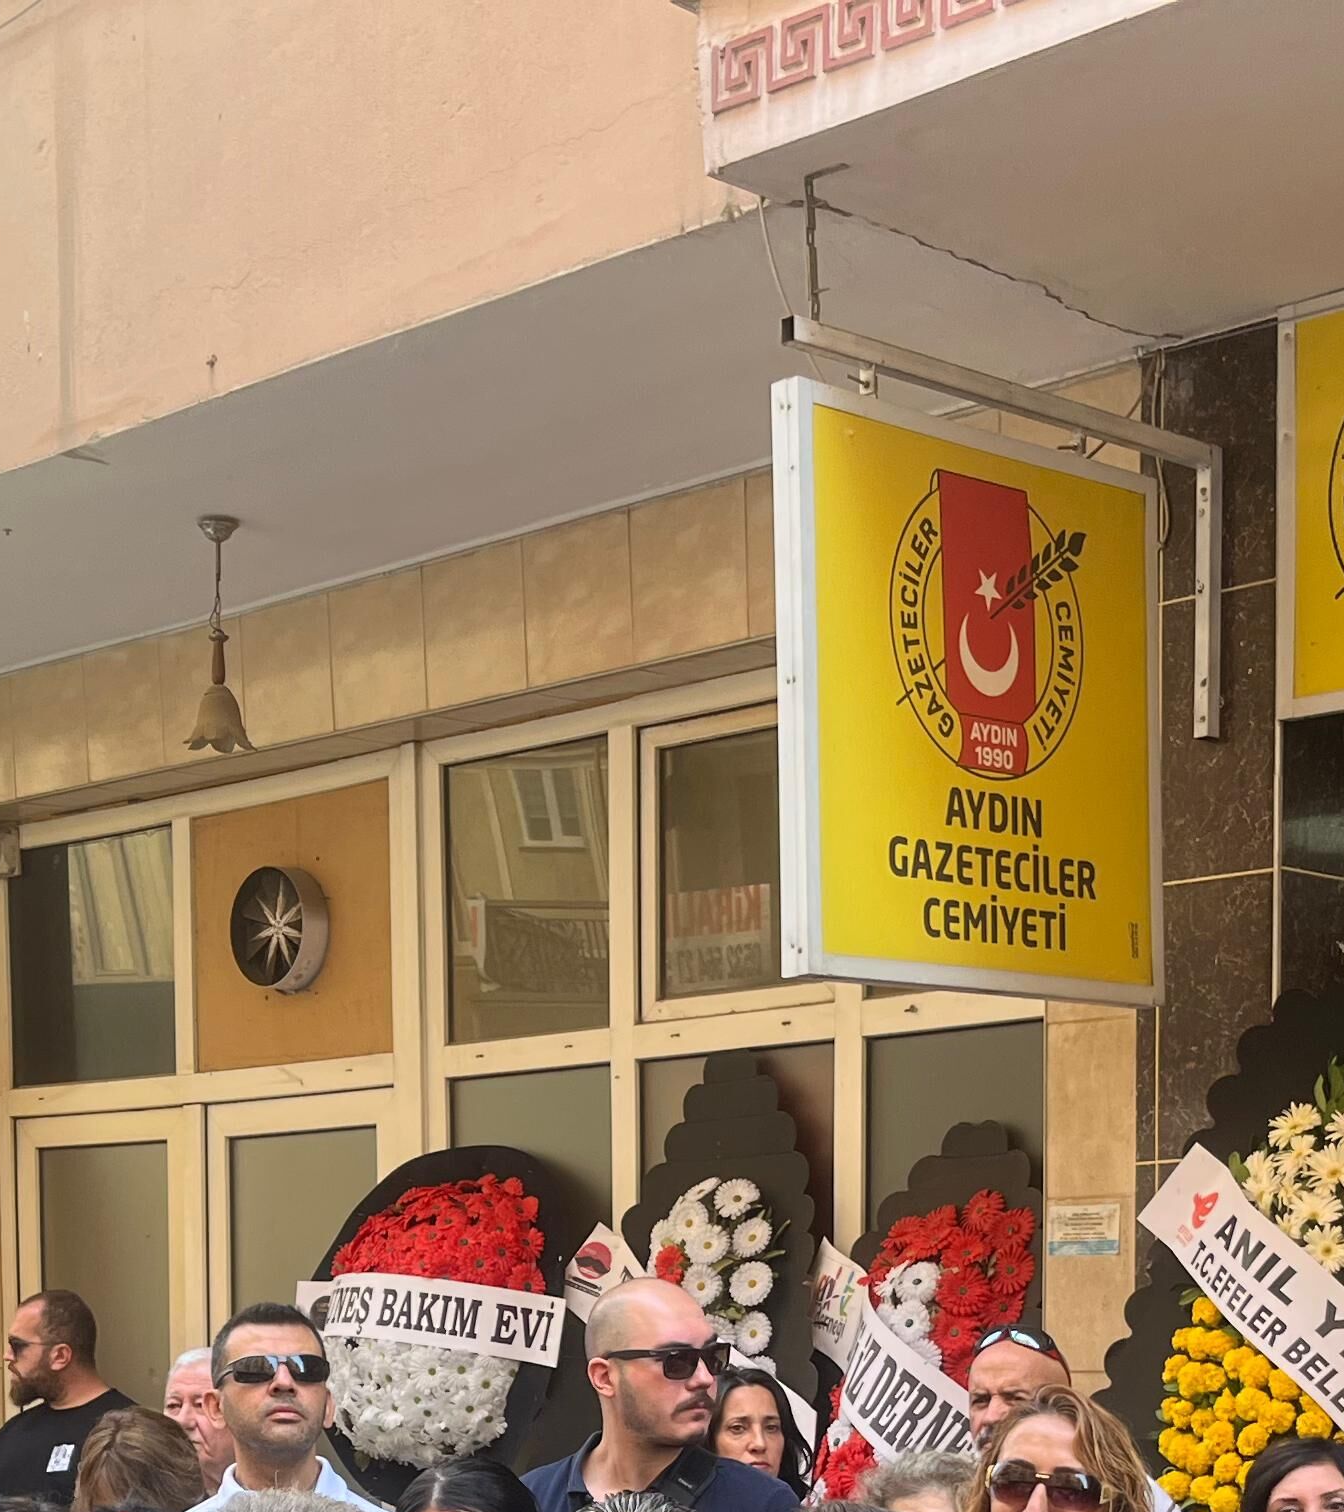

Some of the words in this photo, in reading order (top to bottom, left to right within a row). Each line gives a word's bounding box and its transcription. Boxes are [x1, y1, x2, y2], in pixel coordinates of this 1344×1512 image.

[900, 517, 955, 738] GAZETECİLER
[1032, 601, 1080, 753] CEMİYETİ
[970, 722, 1018, 748] AYDIN
[974, 746, 1014, 770] 1990
[945, 787, 1043, 838] AYDIN
[888, 836, 1097, 900] GAZETECİLER
[923, 897, 1067, 952] CEMİYETİ
[1214, 1214, 1299, 1305] ANIL
[376, 1287, 482, 1339] BAKIM
[490, 1301, 554, 1351] EVİ
